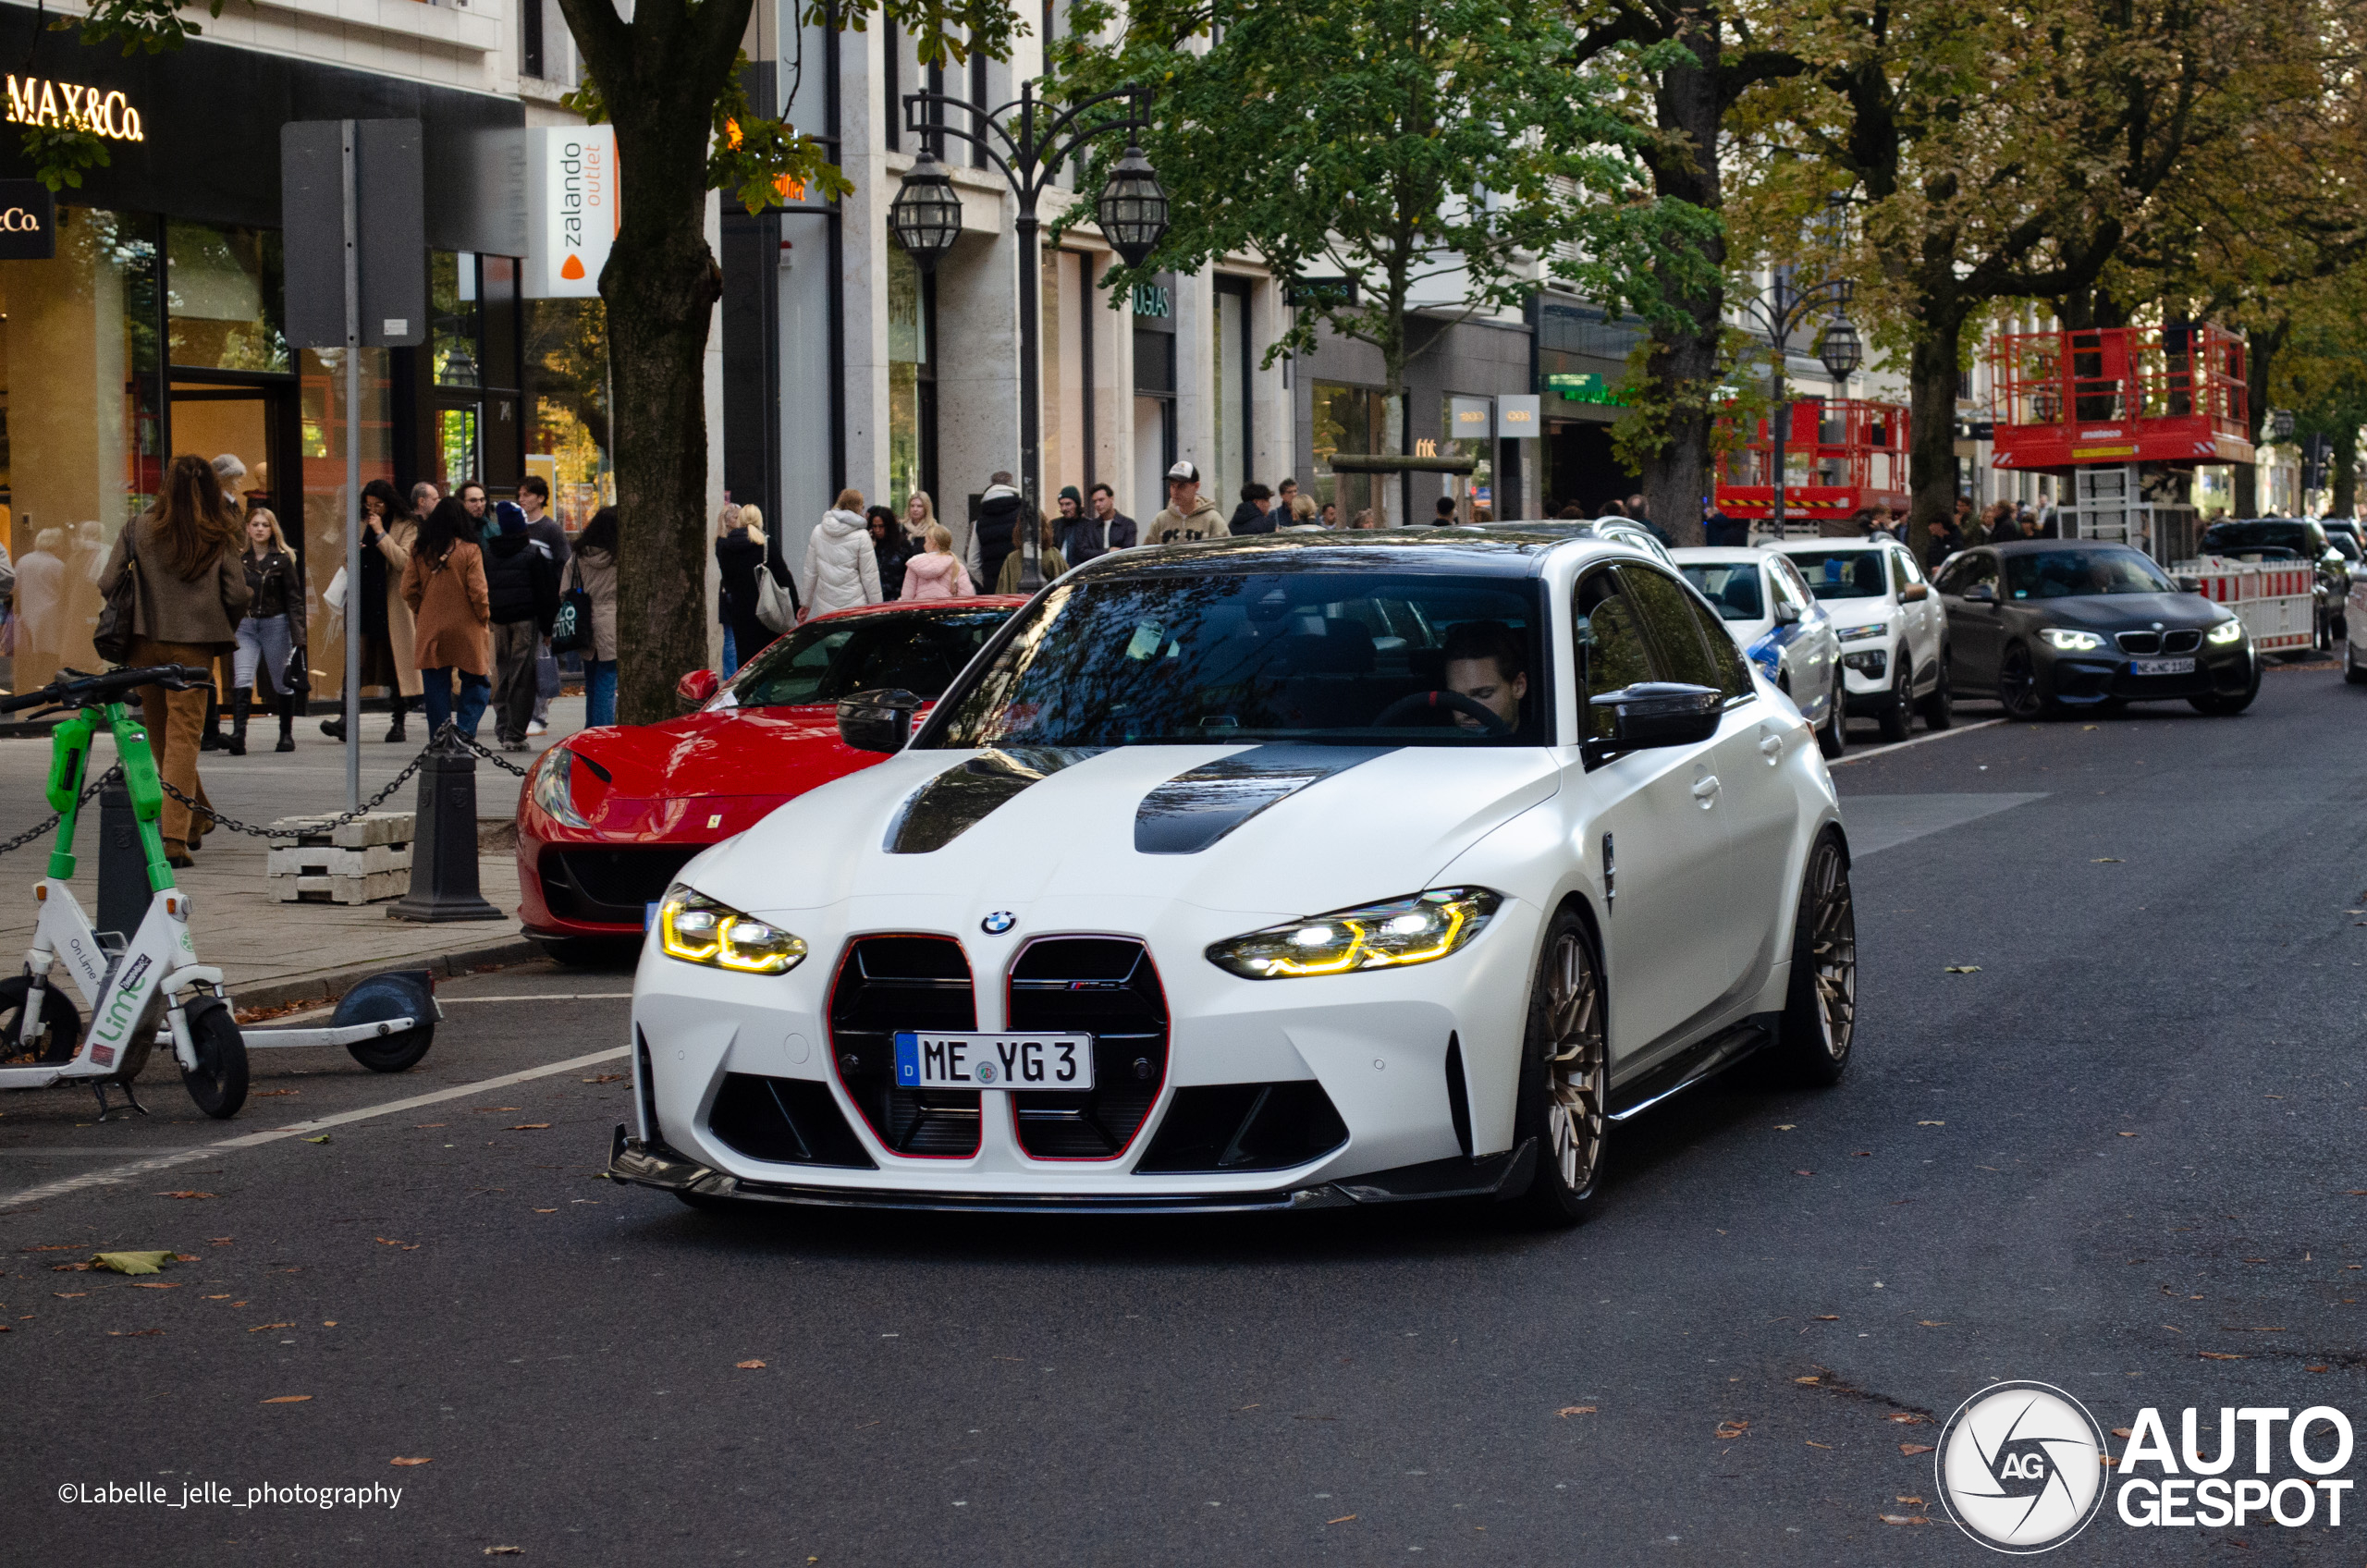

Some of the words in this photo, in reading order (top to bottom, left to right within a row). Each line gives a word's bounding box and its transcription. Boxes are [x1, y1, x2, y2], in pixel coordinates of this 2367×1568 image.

[6, 74, 143, 141] MAX&Co.
[560, 142, 582, 247] zalando
[584, 143, 601, 206] outlet
[0, 207, 40, 231] Co.
[70, 938, 83, 956] On
[79, 953, 98, 980] Lime
[903, 1065, 914, 1077] D
[924, 1040, 971, 1081] ME
[996, 1042, 1045, 1082] YG
[1054, 1042, 1077, 1082] 3
